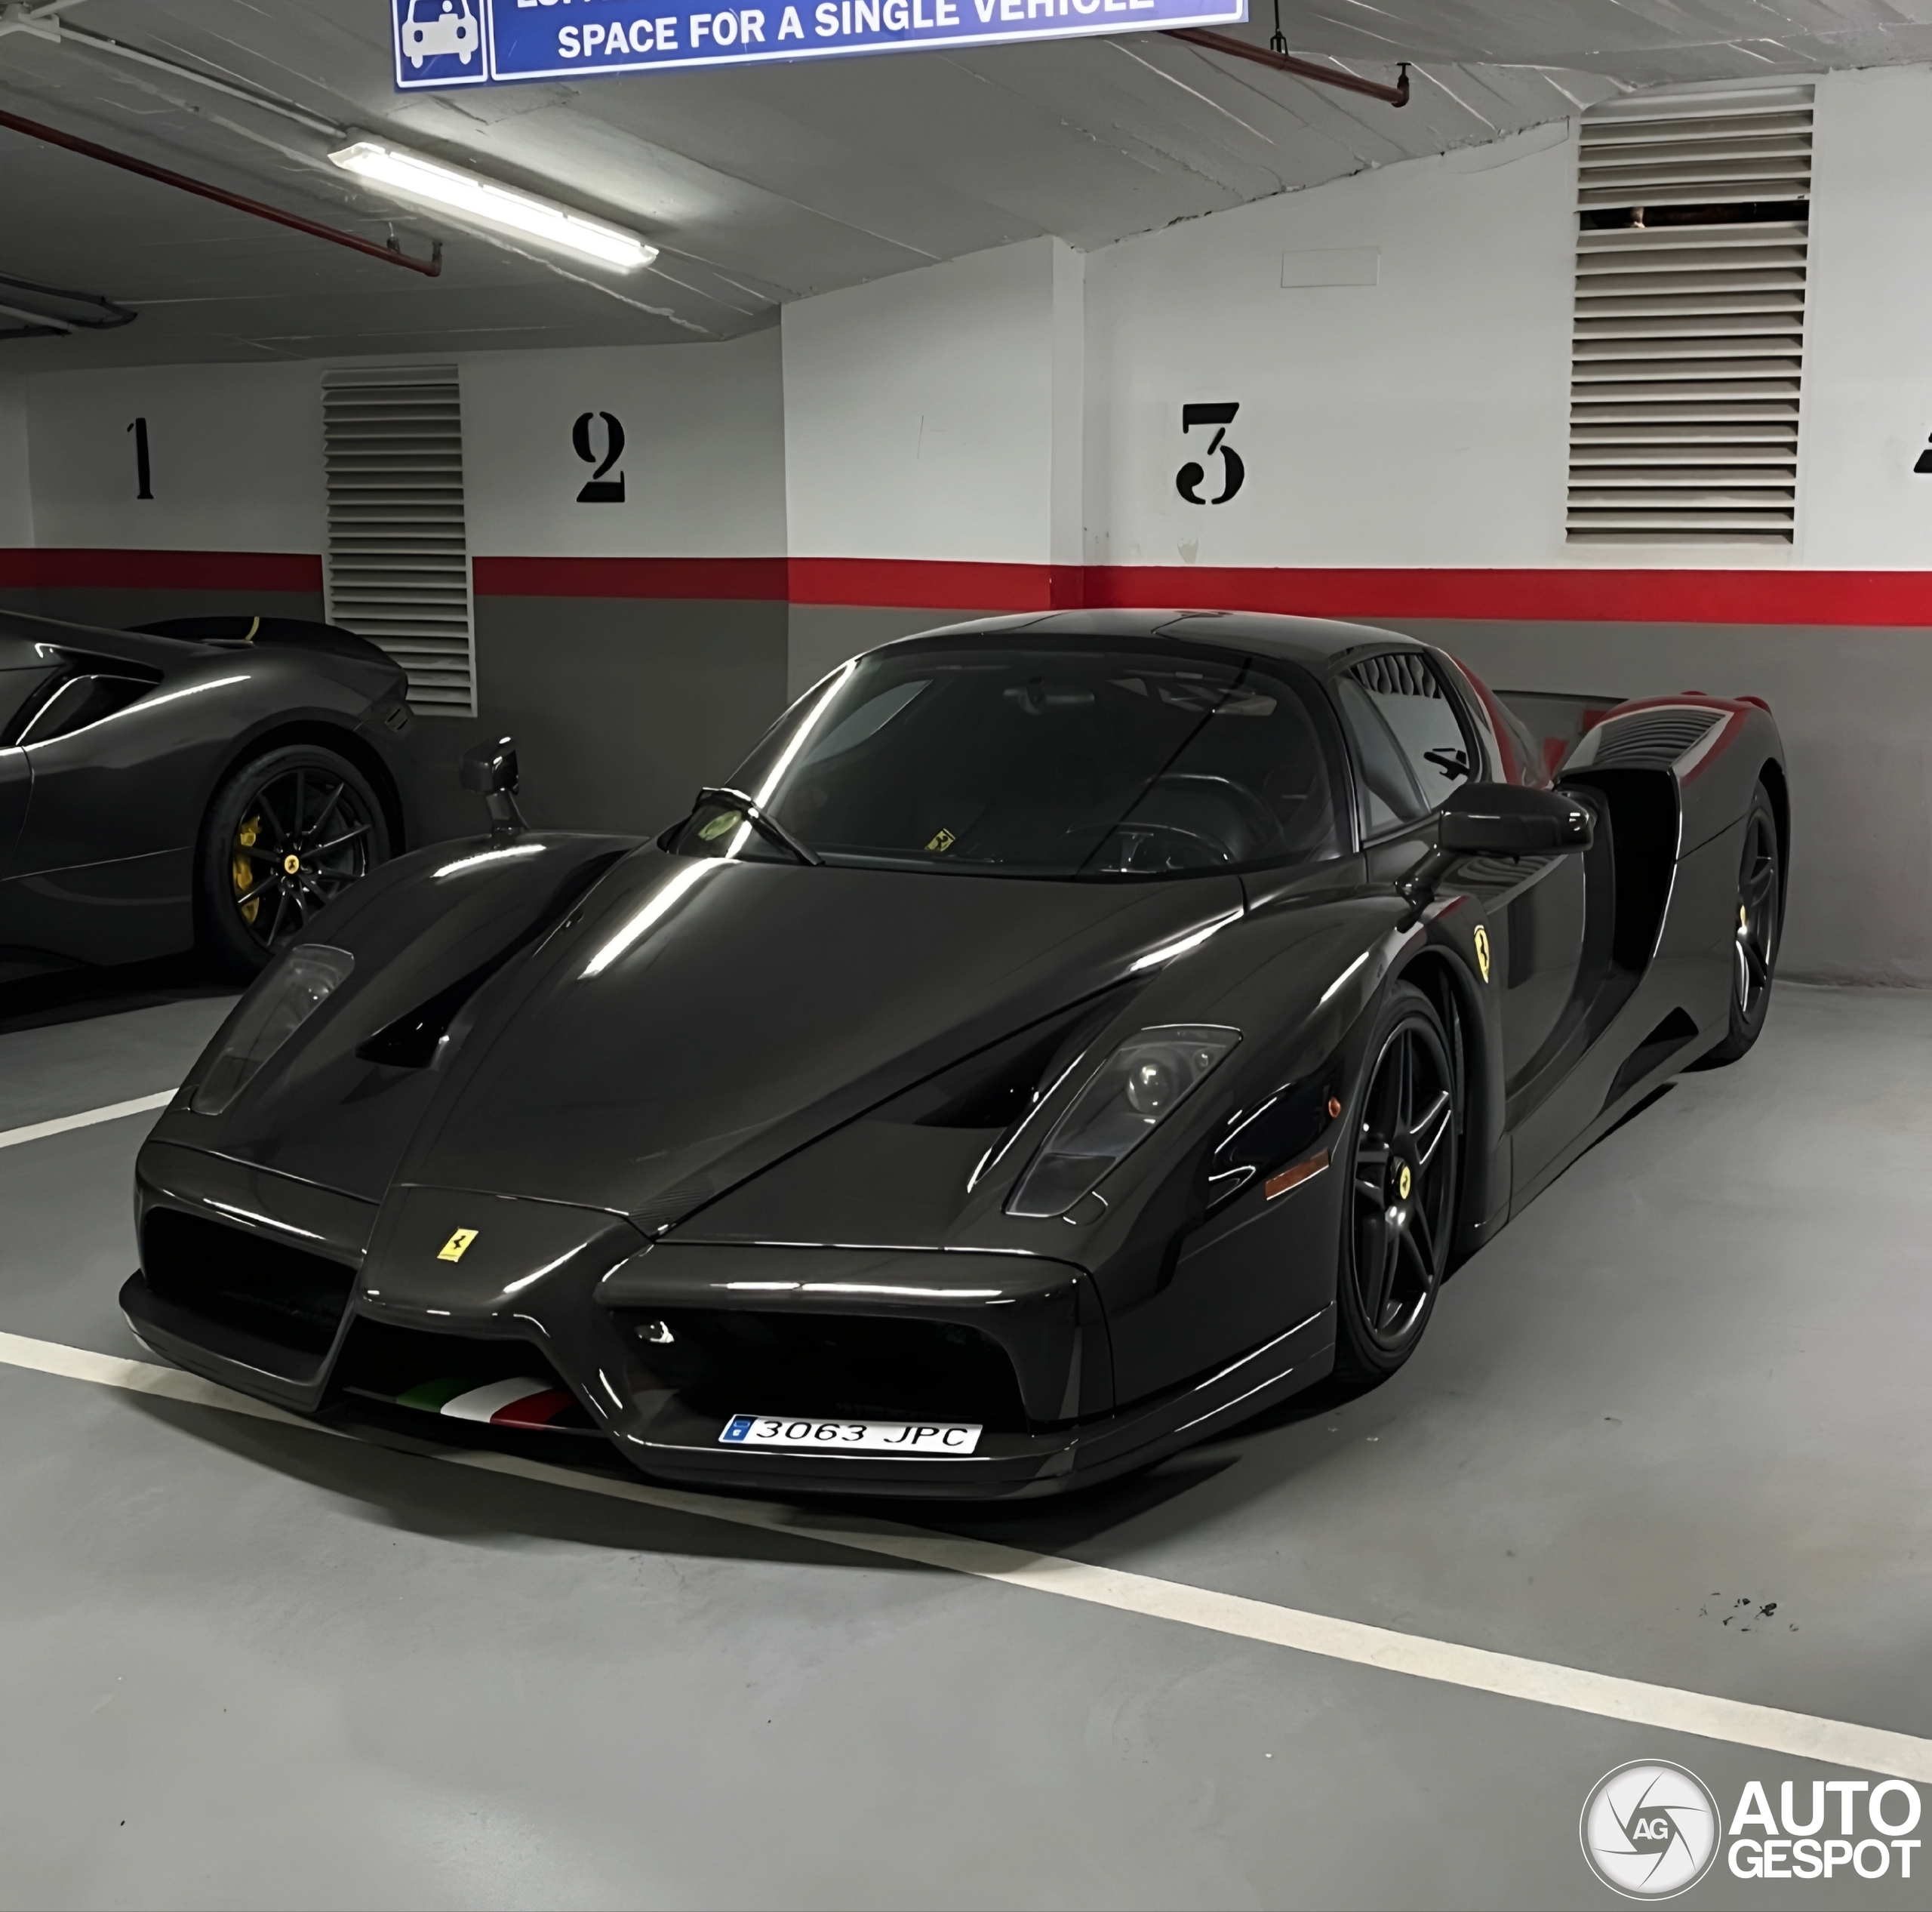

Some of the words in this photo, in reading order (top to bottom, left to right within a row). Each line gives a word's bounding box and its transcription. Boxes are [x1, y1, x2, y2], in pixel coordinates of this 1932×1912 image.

[558, 26, 678, 58] SPACE
[690, 9, 766, 48] FOR
[777, 6, 804, 40] A
[815, 0, 960, 36] SINGLE
[127, 417, 154, 499] 1
[572, 411, 626, 503] 2
[1176, 402, 1245, 505] 3
[756, 1420, 867, 1441] 3063
[883, 1426, 968, 1446] JPC
